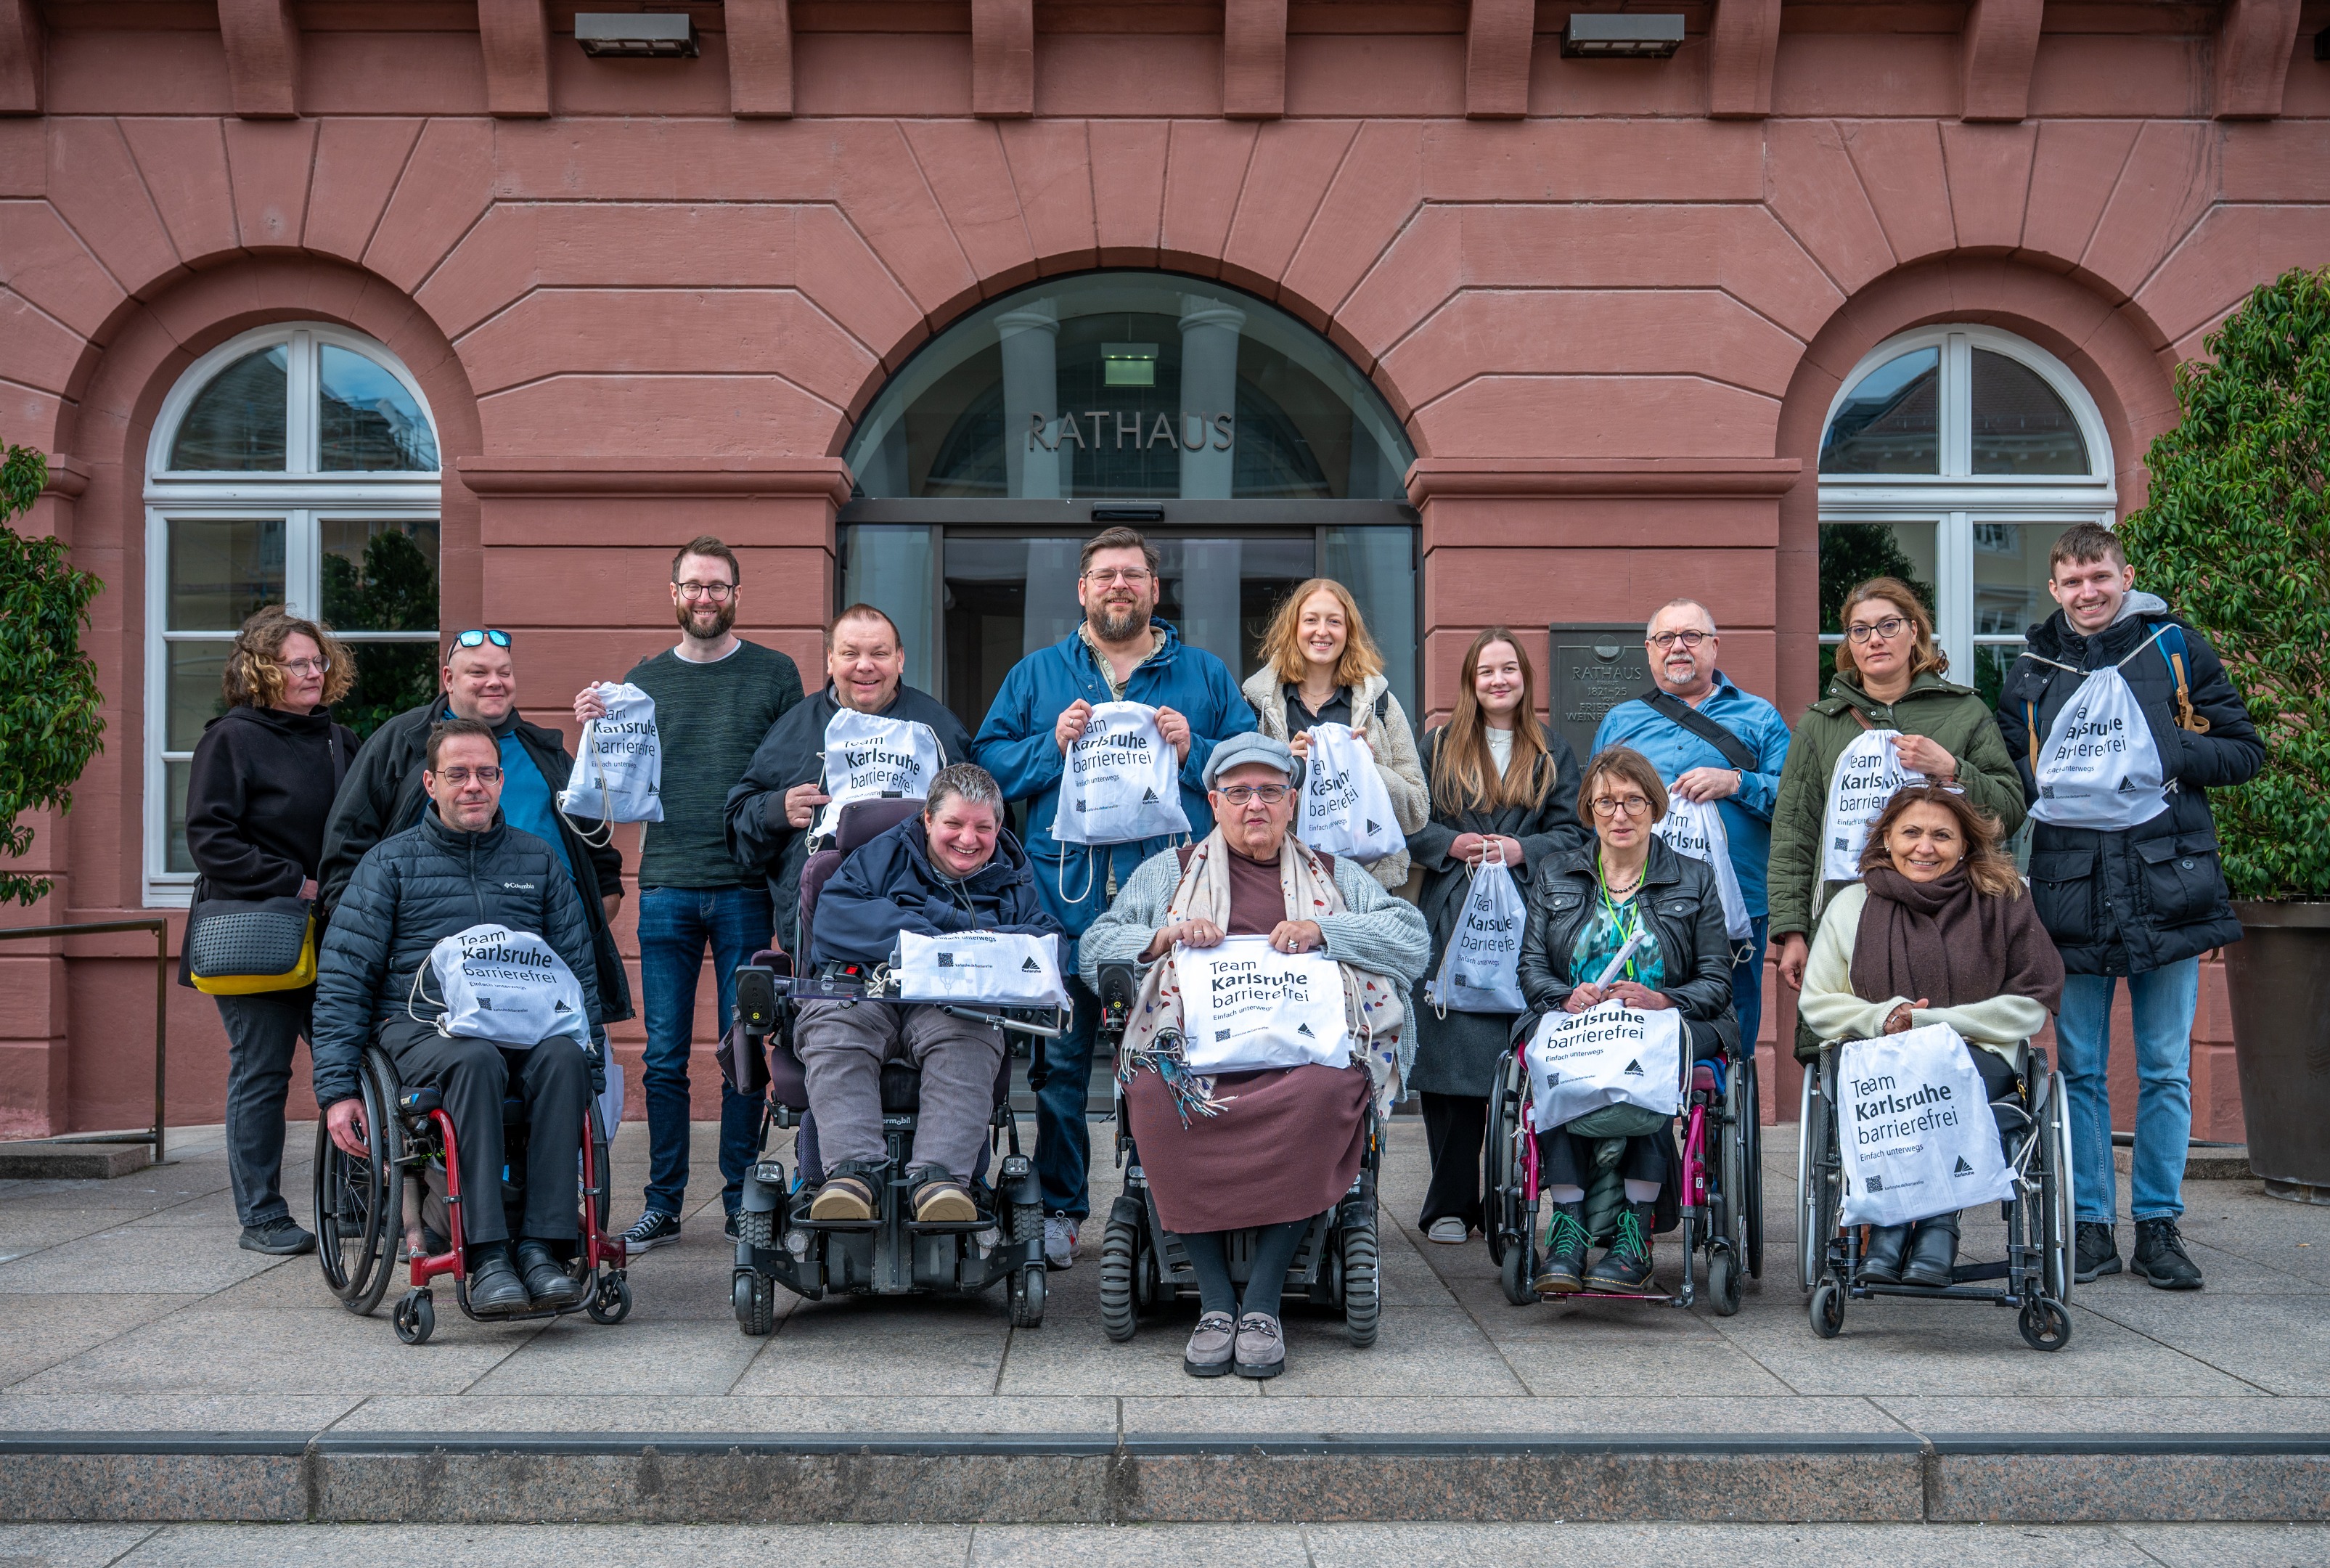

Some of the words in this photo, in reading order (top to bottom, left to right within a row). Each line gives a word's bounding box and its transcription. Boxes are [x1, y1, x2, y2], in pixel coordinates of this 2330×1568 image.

[1029, 411, 1233, 451] RATHAUS
[1572, 666, 1642, 681] RATHAUS
[1579, 702, 1619, 712] FRIED
[591, 738, 655, 757] barrierefre
[1071, 730, 1148, 754] Karlsruhe
[845, 748, 920, 776] Karlsruhe
[1072, 751, 1152, 773] barrierefrei
[851, 767, 915, 794] barrierefrei
[1090, 775, 1120, 785] unterwegs
[1839, 793, 1887, 812] barrier
[457, 930, 506, 947] Team
[462, 944, 553, 968] Karlsruhe
[1457, 954, 1476, 965] Einfach
[462, 963, 557, 984] barrierefrei
[1209, 960, 1256, 975] Team
[1211, 971, 1307, 992] Karlsruhe
[1212, 984, 1309, 1009] barrierefrei
[1213, 1009, 1238, 1021] Einfach
[1238, 1005, 1274, 1016] unterwegs
[1547, 1024, 1644, 1049] barrierefrei
[1545, 1053, 1569, 1063] Einfach
[1569, 1048, 1604, 1058] unterwegs
[1850, 1074, 1897, 1098] Team
[1855, 1083, 1953, 1122] Karlsruhe
[883, 1116, 911, 1125] ermobil
[1857, 1106, 1959, 1145] barrierefrei
[1860, 1150, 1885, 1162] Einfach
[1886, 1143, 1924, 1156] unterwegs
